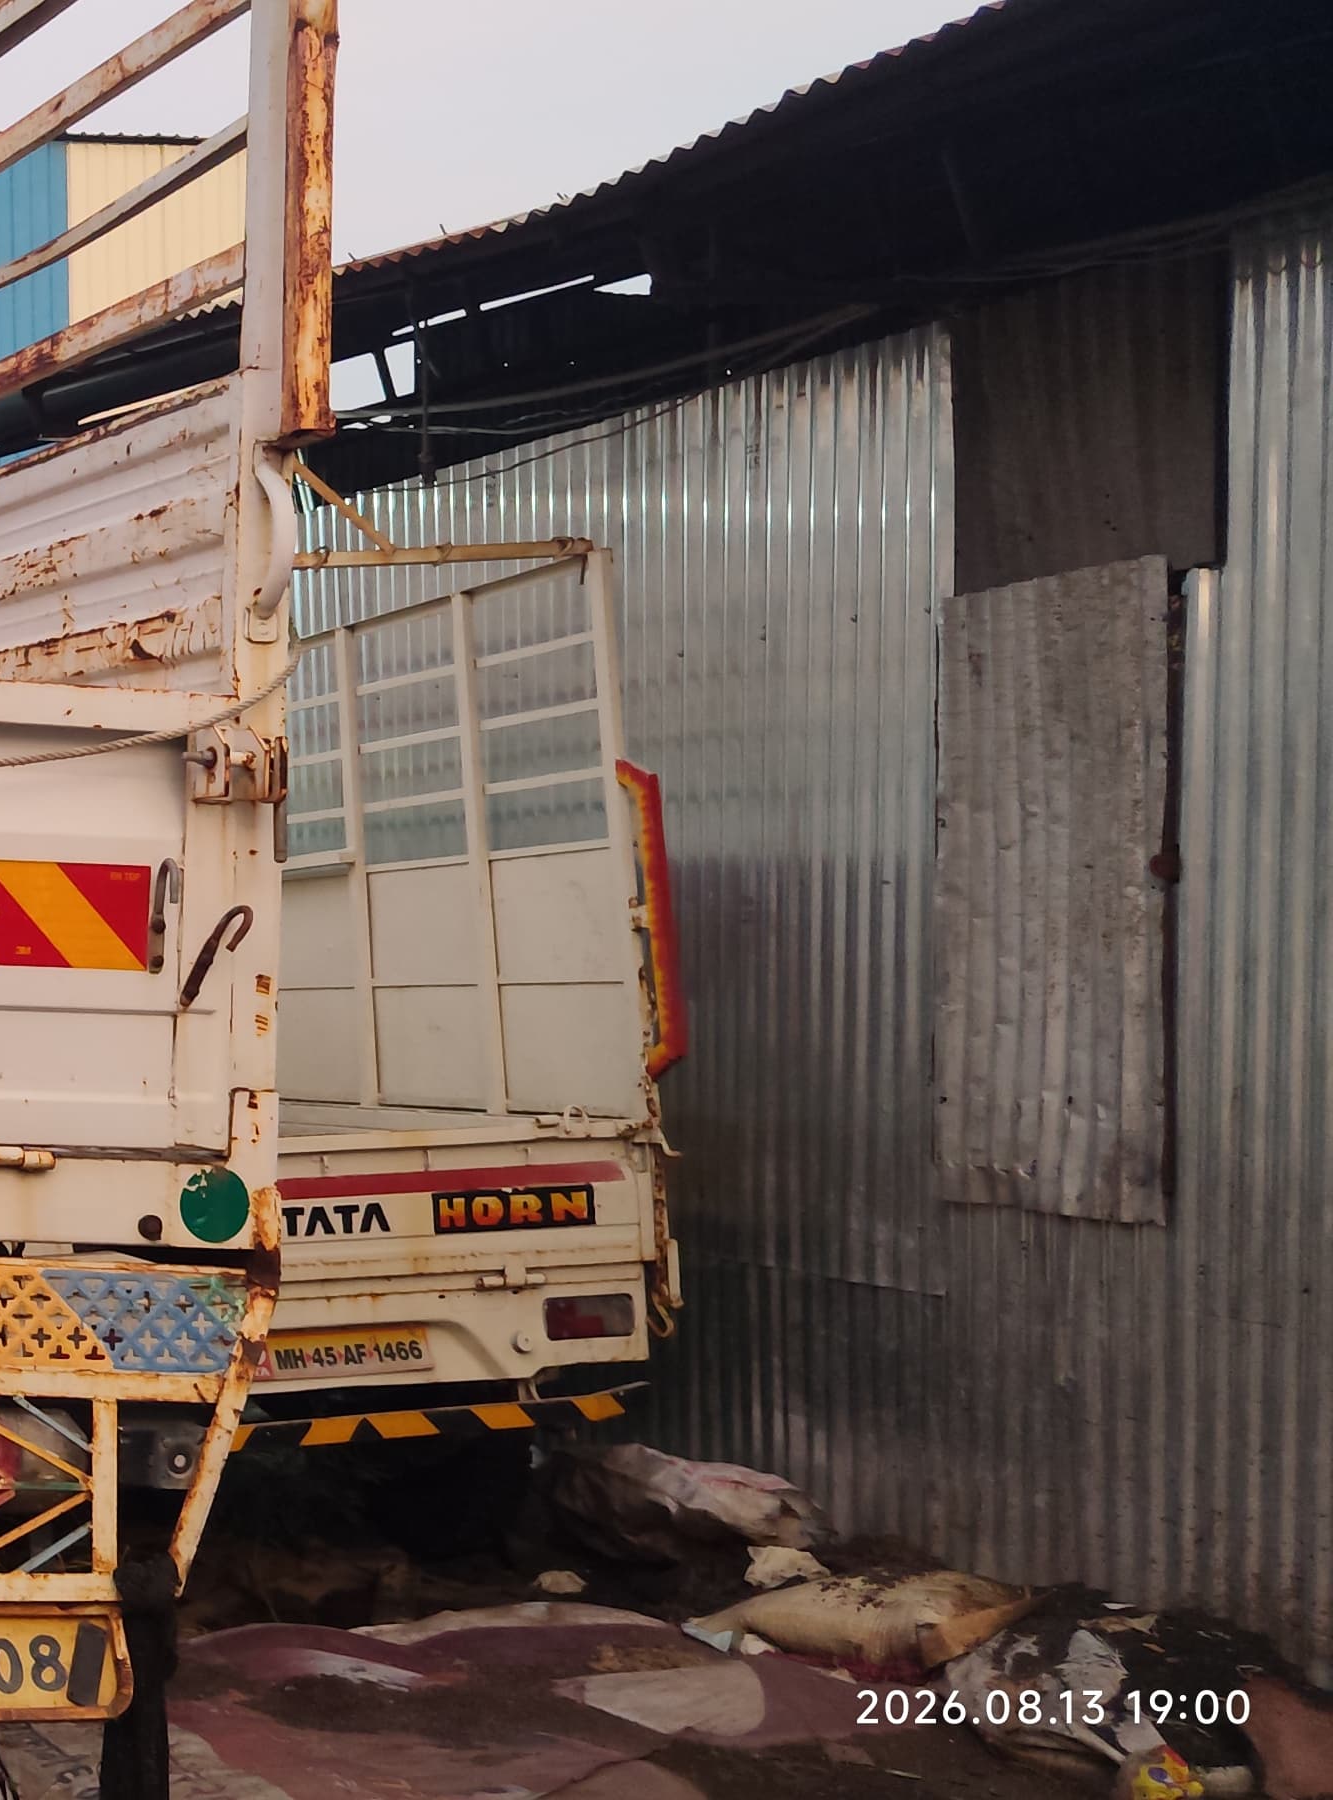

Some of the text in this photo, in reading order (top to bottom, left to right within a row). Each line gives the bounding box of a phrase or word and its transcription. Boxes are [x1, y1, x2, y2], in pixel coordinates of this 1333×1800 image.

[282, 1202, 391, 1237] TATA
[438, 1190, 590, 1230] HORN
[274, 1340, 423, 1370] MH 45 AF 1466
